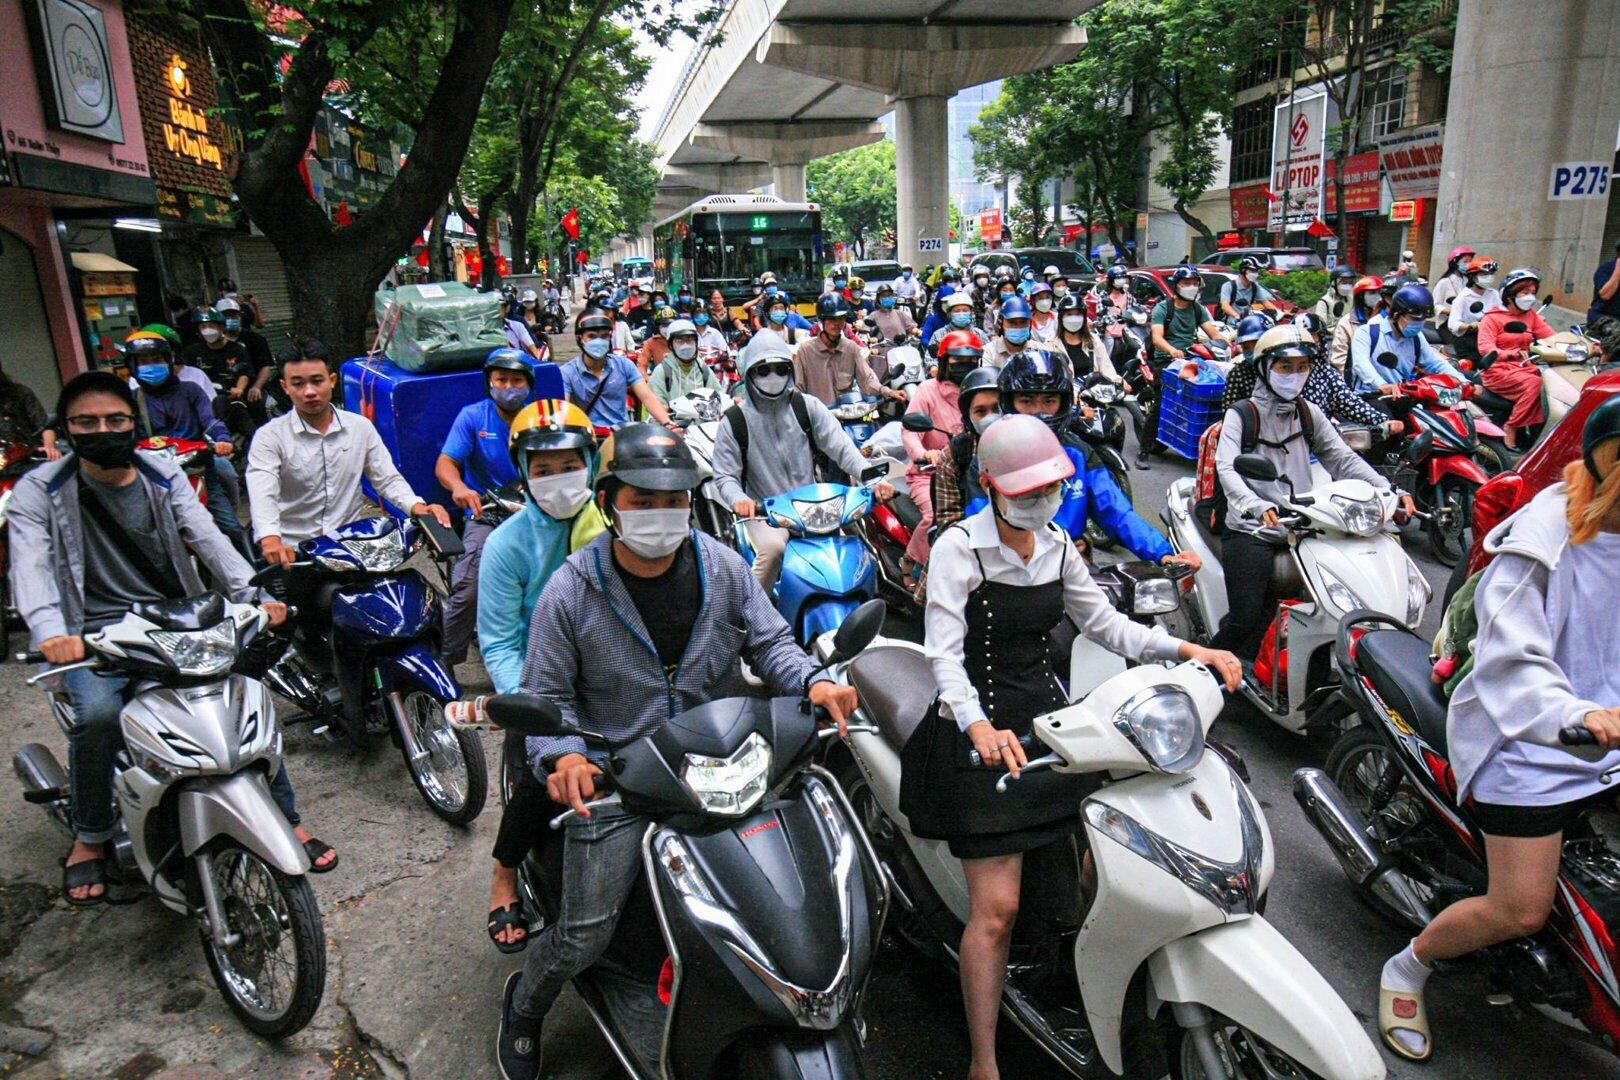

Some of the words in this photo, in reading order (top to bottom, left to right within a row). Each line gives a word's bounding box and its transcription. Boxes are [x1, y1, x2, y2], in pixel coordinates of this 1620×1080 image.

[169, 98, 197, 131] Bánh
[1554, 166, 1609, 196] P275
[753, 217, 766, 228] 16
[920, 239, 941, 250] P274
[1171, 776, 1197, 790] HONDA
[741, 820, 779, 839] HONDA
